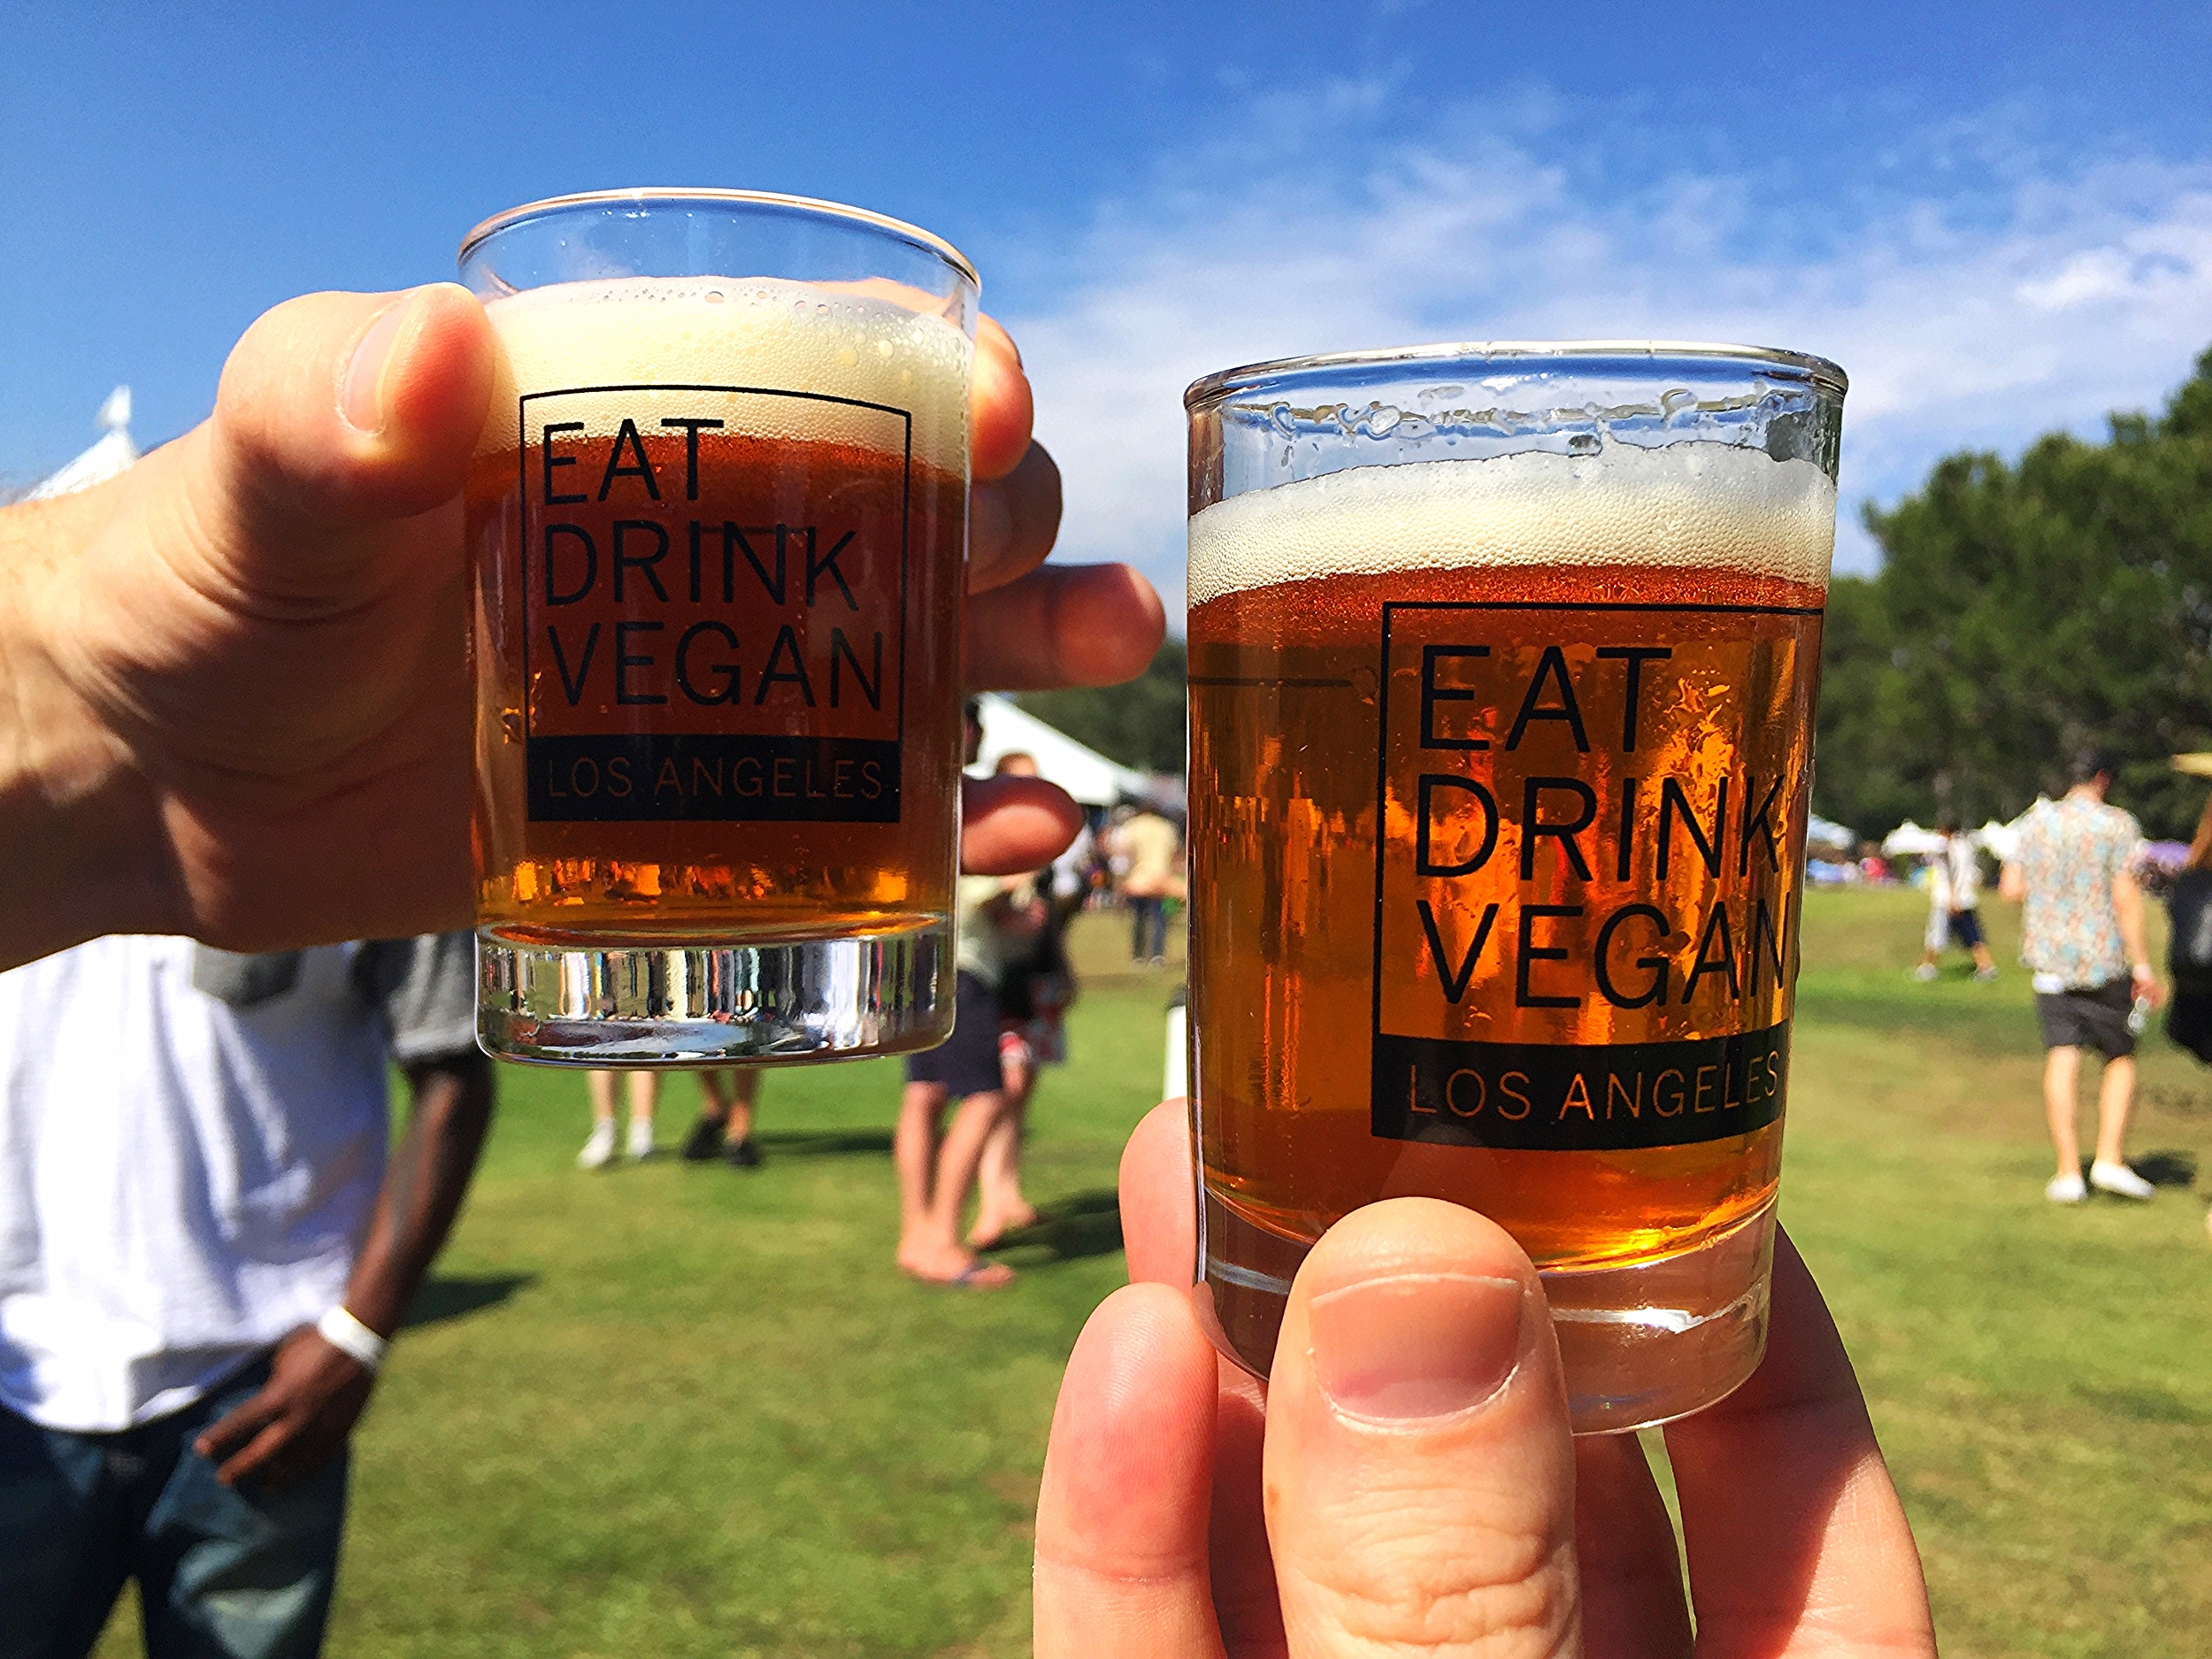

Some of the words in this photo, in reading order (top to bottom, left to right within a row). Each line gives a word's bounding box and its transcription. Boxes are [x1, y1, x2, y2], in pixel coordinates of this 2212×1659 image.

[543, 418, 725, 506] EAT
[544, 519, 860, 611] DRINK
[546, 619, 882, 711] VEGAN
[1419, 644, 1673, 753] EAT
[548, 757, 633, 797] LOS
[653, 757, 883, 800] ANGELES
[1416, 772, 1786, 883] DRINK
[1416, 891, 1791, 1010] VEGAN
[1409, 1064, 1531, 1121] LOS
[1559, 1049, 1779, 1122] ANGELES
